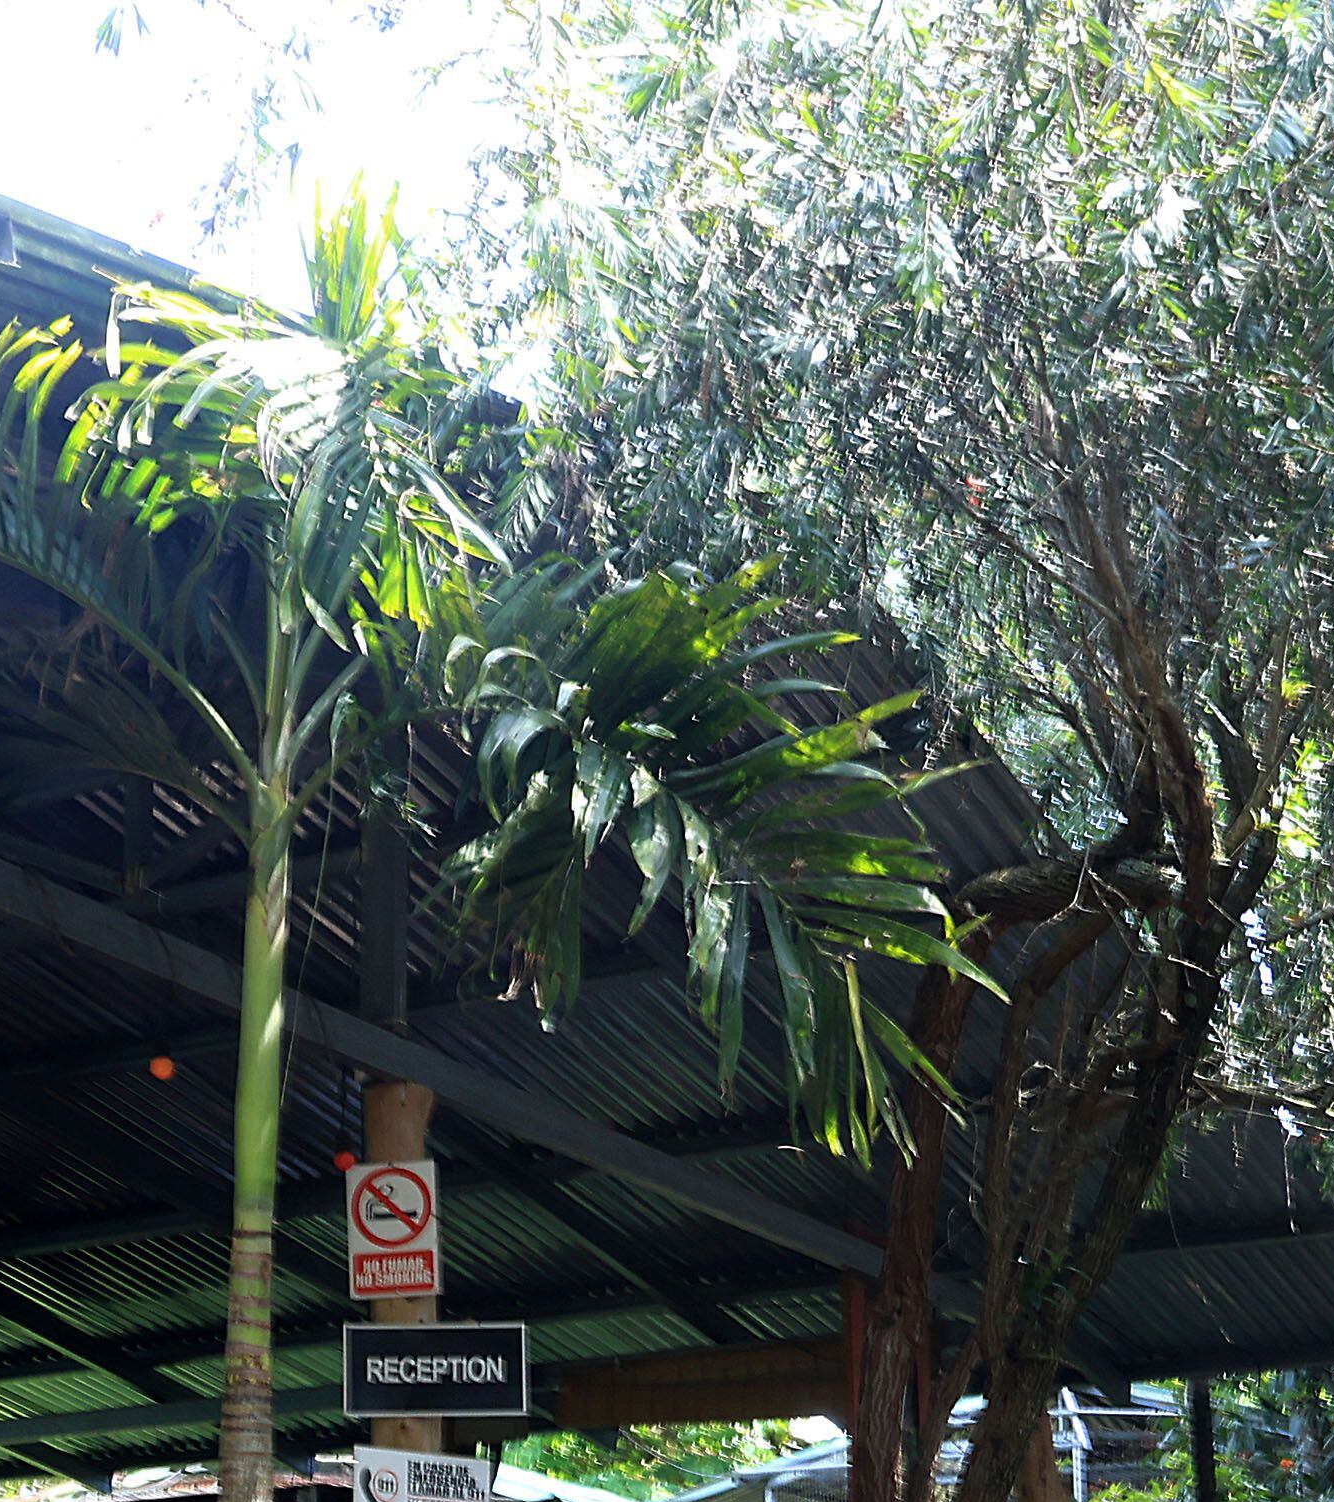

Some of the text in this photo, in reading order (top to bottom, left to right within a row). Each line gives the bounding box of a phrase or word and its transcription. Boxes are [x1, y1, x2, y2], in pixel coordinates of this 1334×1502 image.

[363, 1256, 424, 1274] NO FUMAR
[356, 1269, 432, 1287] NO SMOKING
[366, 1355, 507, 1384] RECEPTION
[377, 1478, 394, 1493] 911
